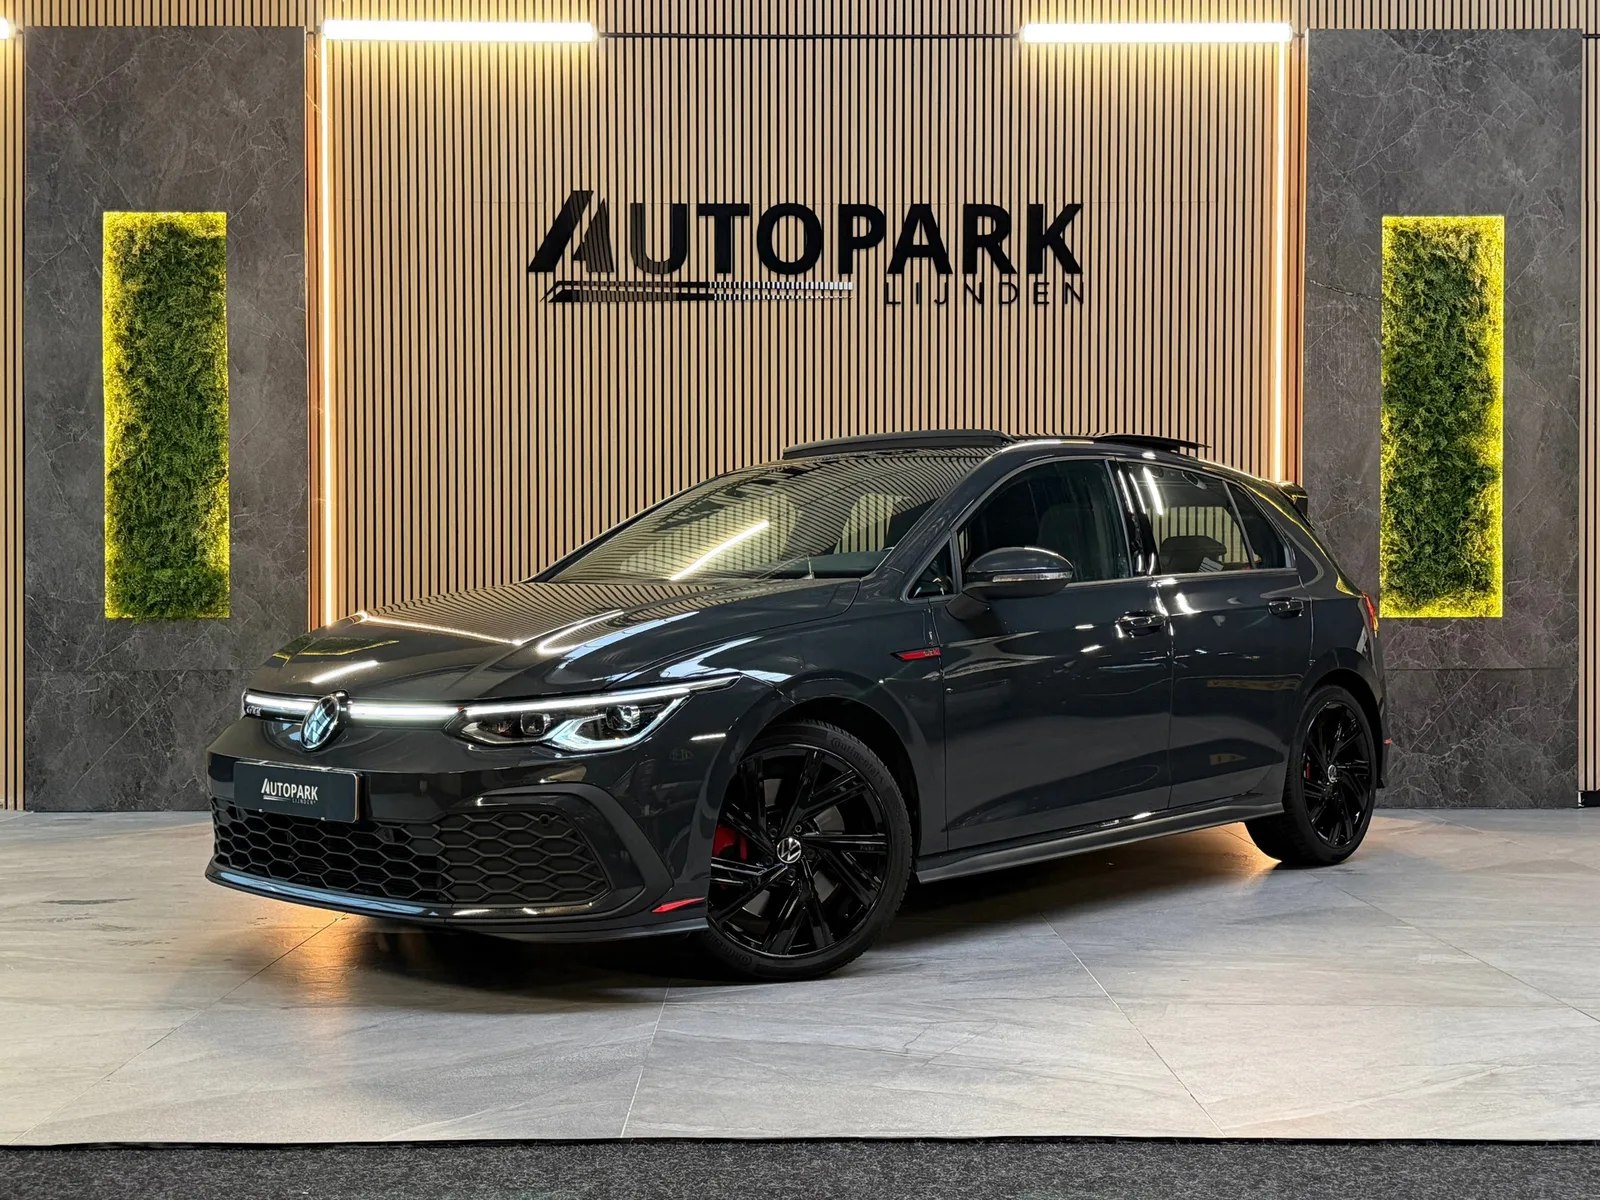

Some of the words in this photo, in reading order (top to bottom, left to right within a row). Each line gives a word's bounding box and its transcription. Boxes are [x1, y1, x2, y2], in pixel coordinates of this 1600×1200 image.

[527, 190, 1083, 275] AUTOPARK
[885, 282, 1083, 305] LIJNDEN
[831, 737, 880, 779] Continental
[261, 778, 318, 800] AUTOPARK
